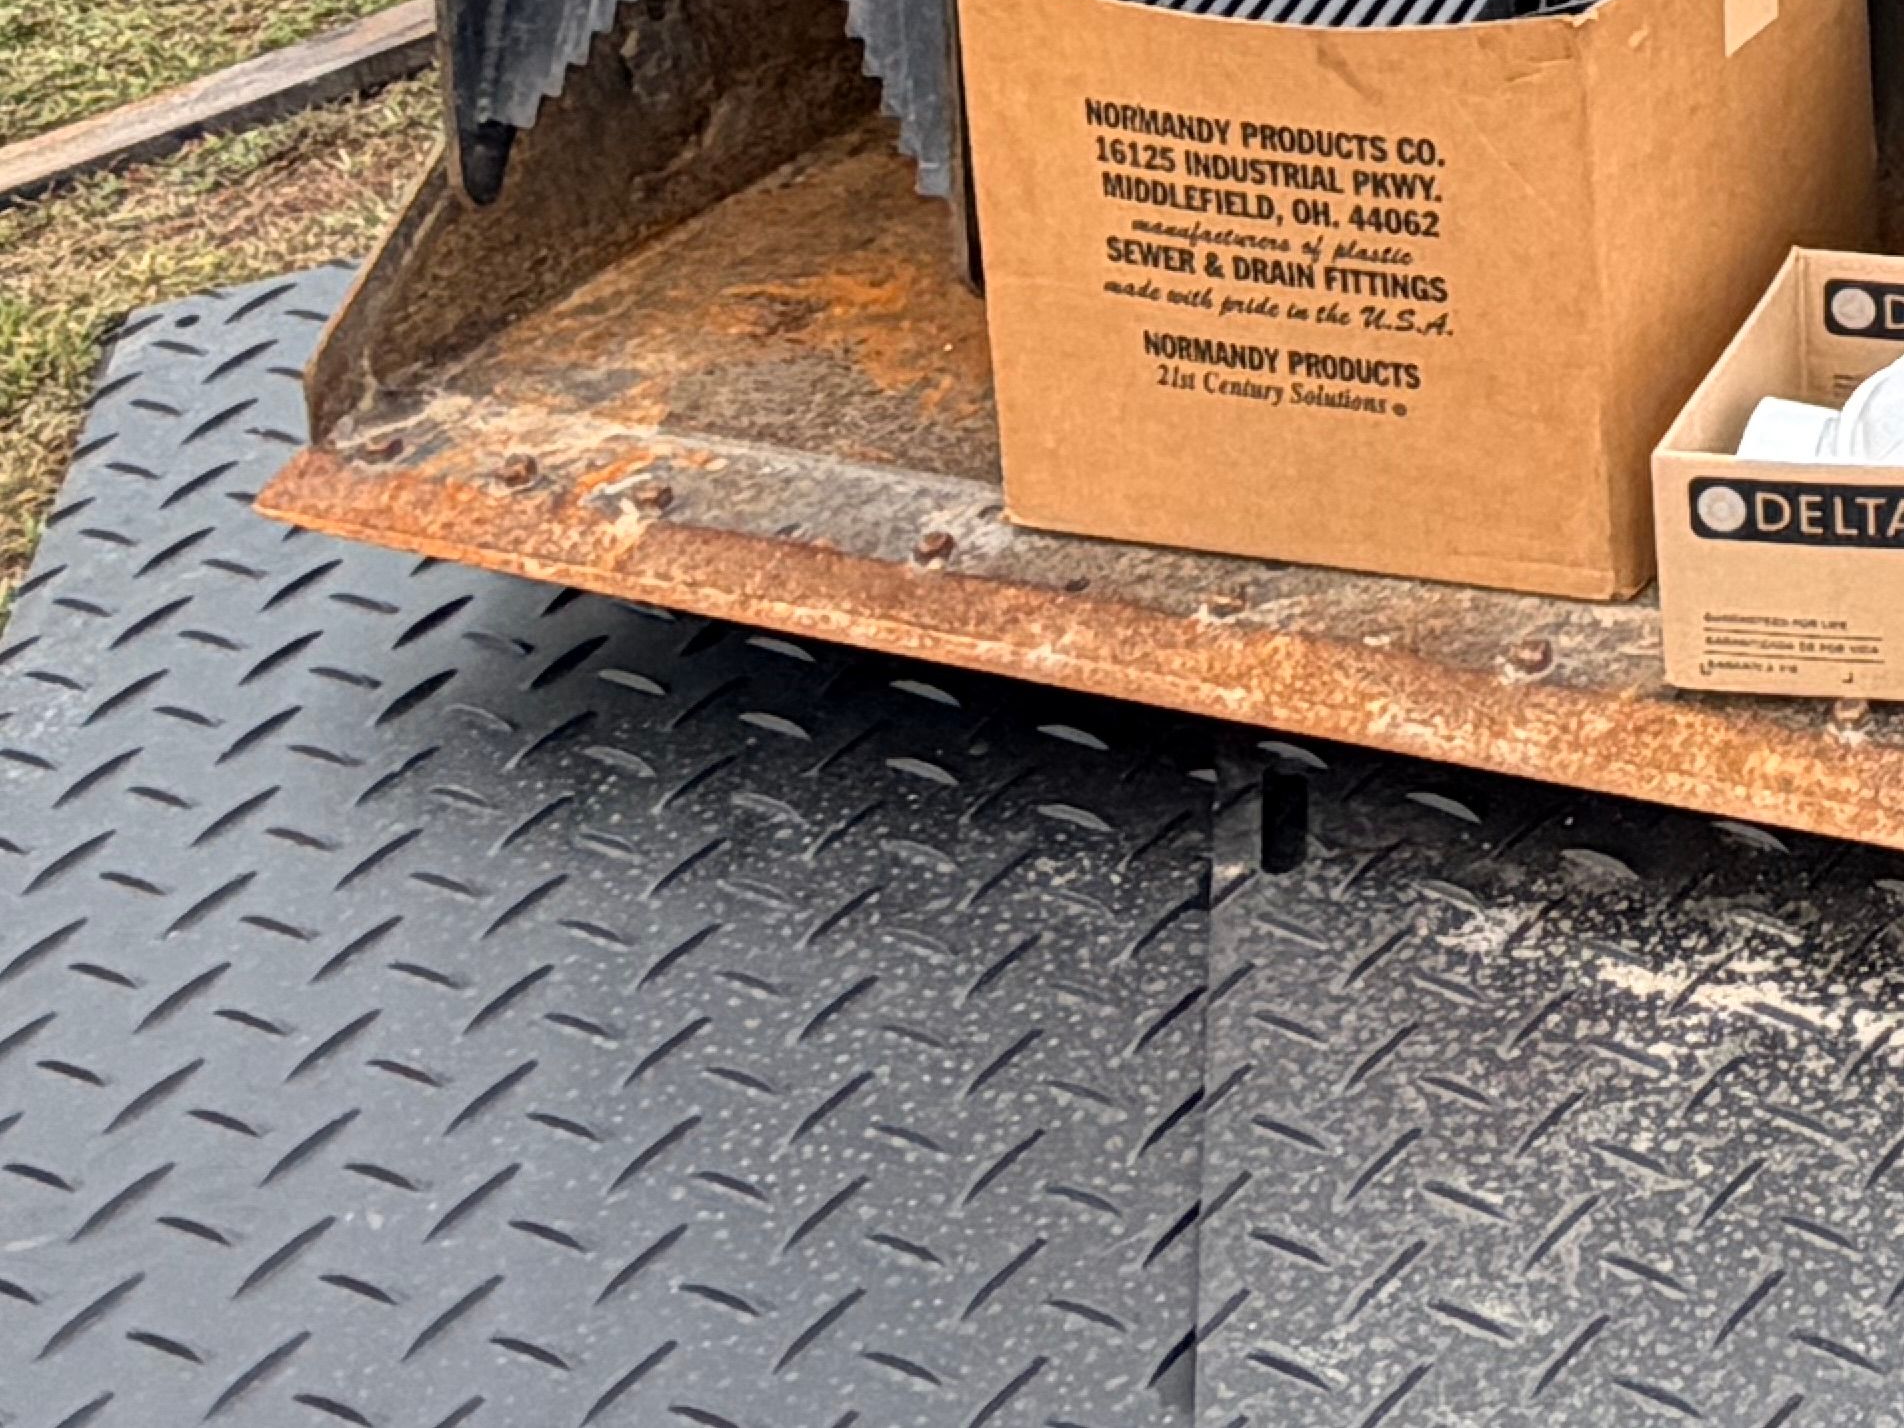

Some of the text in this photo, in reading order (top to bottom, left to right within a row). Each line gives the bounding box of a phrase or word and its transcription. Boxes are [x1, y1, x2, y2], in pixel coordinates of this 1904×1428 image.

[1084, 97, 1446, 168] NORMANDY PRODUCTS CO.
[1095, 135, 1443, 202] 16125 INDUSTRIAL PKWY.
[1101, 171, 1440, 238] MIDDLEFIELD, OH. 44062
[1105, 234, 1448, 303] SEWER & DRAIN FITTINGS
[1130, 219, 1413, 266] manufacturers of plastic
[1103, 278, 1455, 337] made with pride in the U.S.A.
[1142, 328, 1421, 390] NORMANDY PRODUCTS
[1156, 363, 1388, 414] 21st Century Solutions
